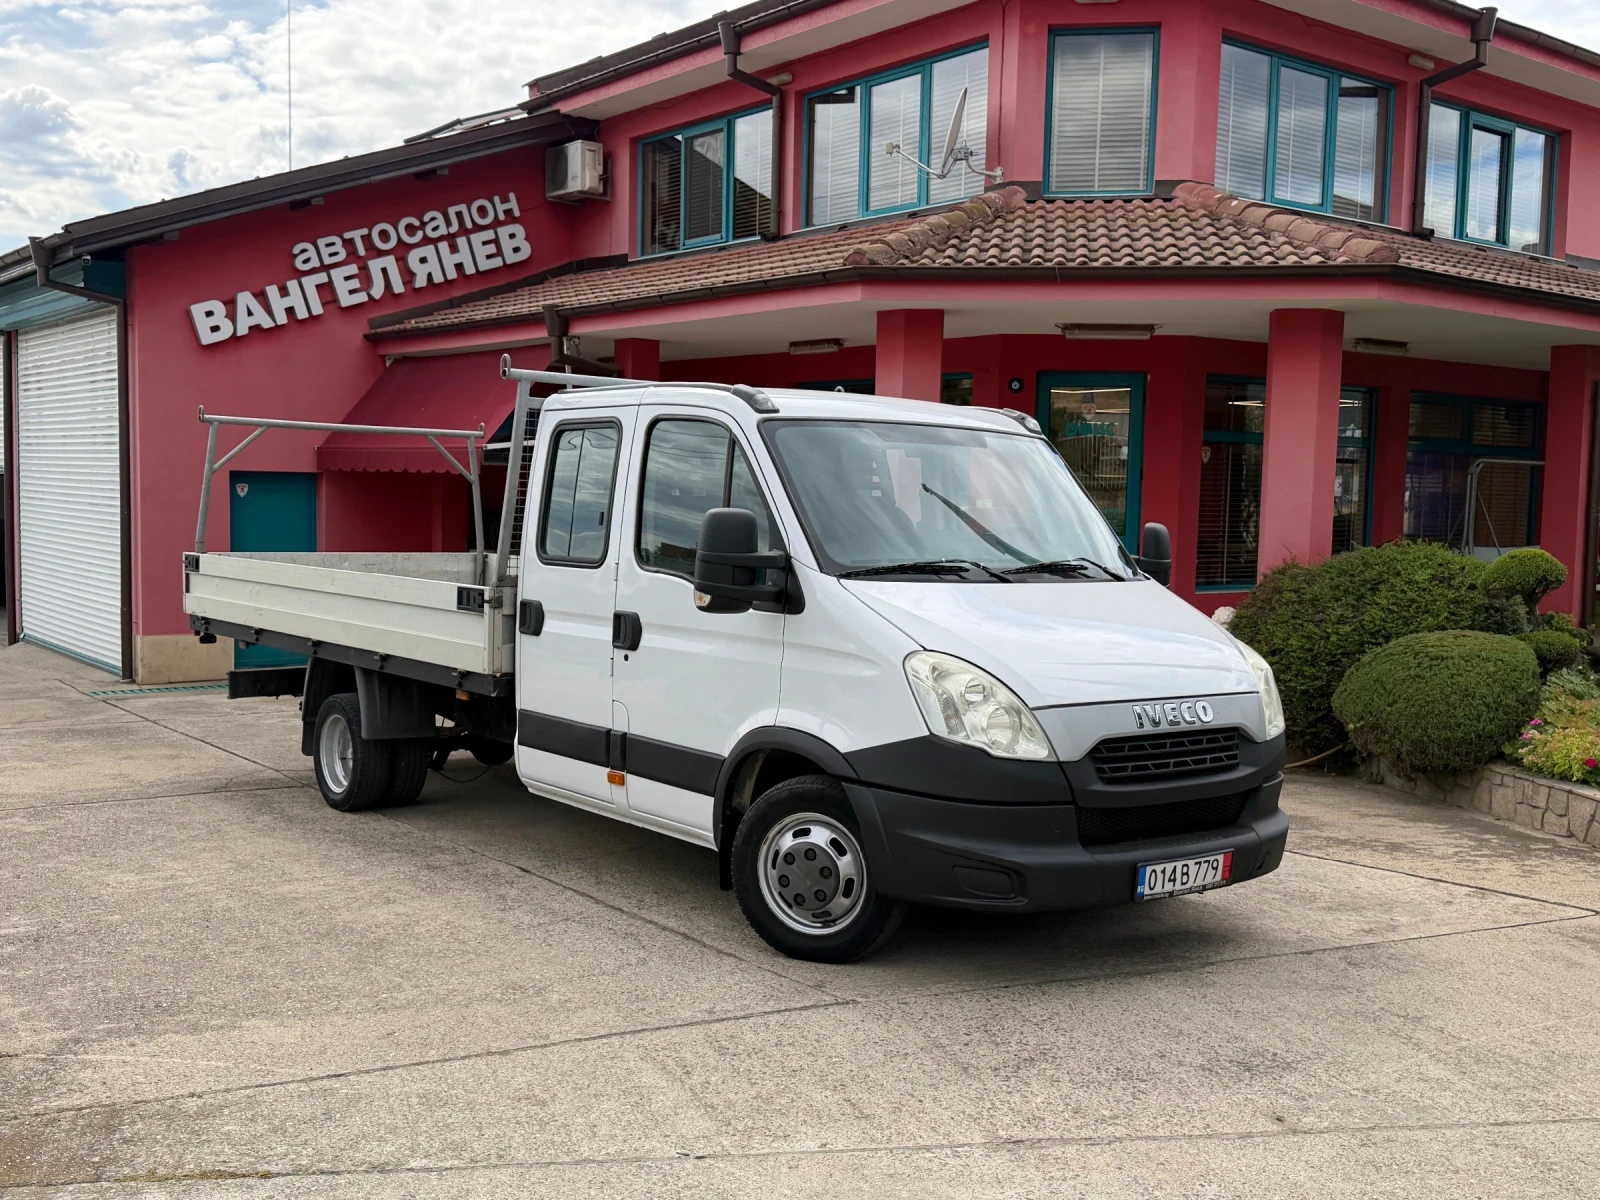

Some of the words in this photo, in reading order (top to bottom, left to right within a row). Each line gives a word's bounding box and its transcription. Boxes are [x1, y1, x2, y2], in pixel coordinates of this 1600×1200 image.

[292, 192, 520, 271] автосалон
[189, 255, 405, 345] ВАНГЕЛ
[406, 223, 532, 289] ЯНЕВ
[1132, 700, 1214, 729] IVECO
